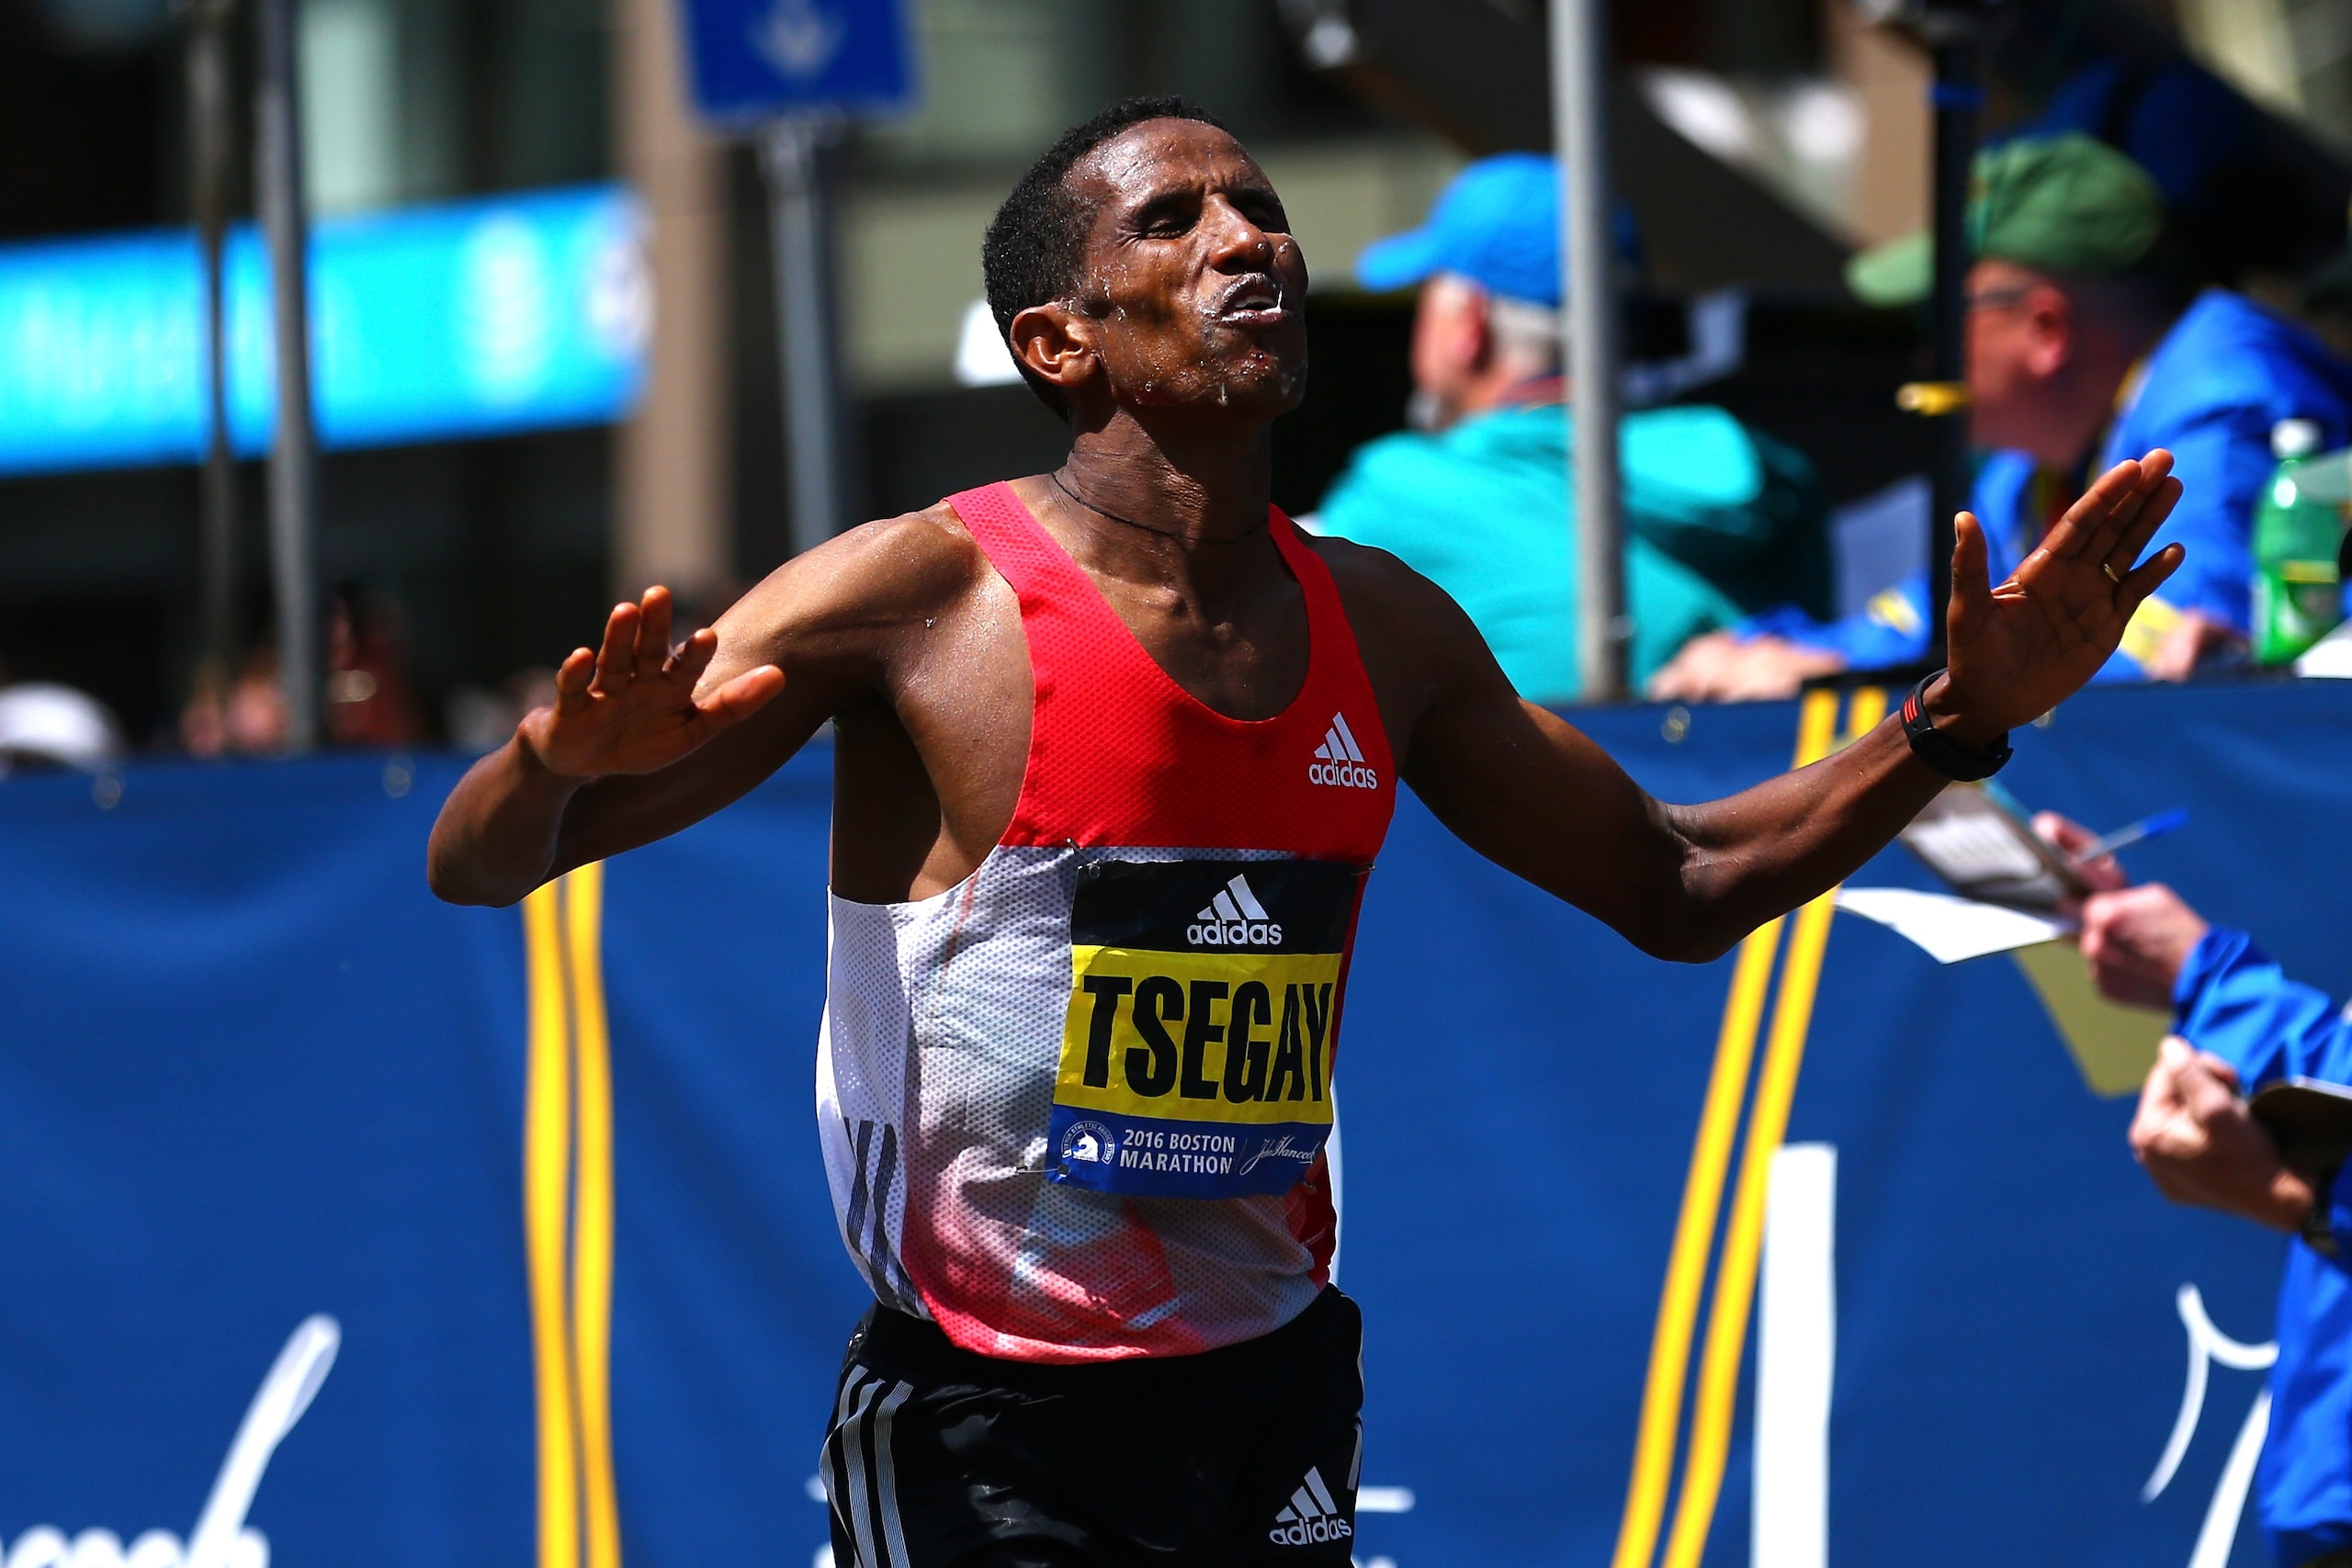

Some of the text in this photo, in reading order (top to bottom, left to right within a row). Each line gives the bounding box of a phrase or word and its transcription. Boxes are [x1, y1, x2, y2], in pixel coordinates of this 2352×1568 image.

[1308, 759, 1377, 789] adidas
[1186, 919, 1283, 945] adidas
[1082, 975, 1333, 1104] TSEGAY
[1123, 1129, 1236, 1153] 2016 BOSTON
[1119, 1149, 1233, 1175] MARATHON
[1269, 1514, 1353, 1546] adidas
